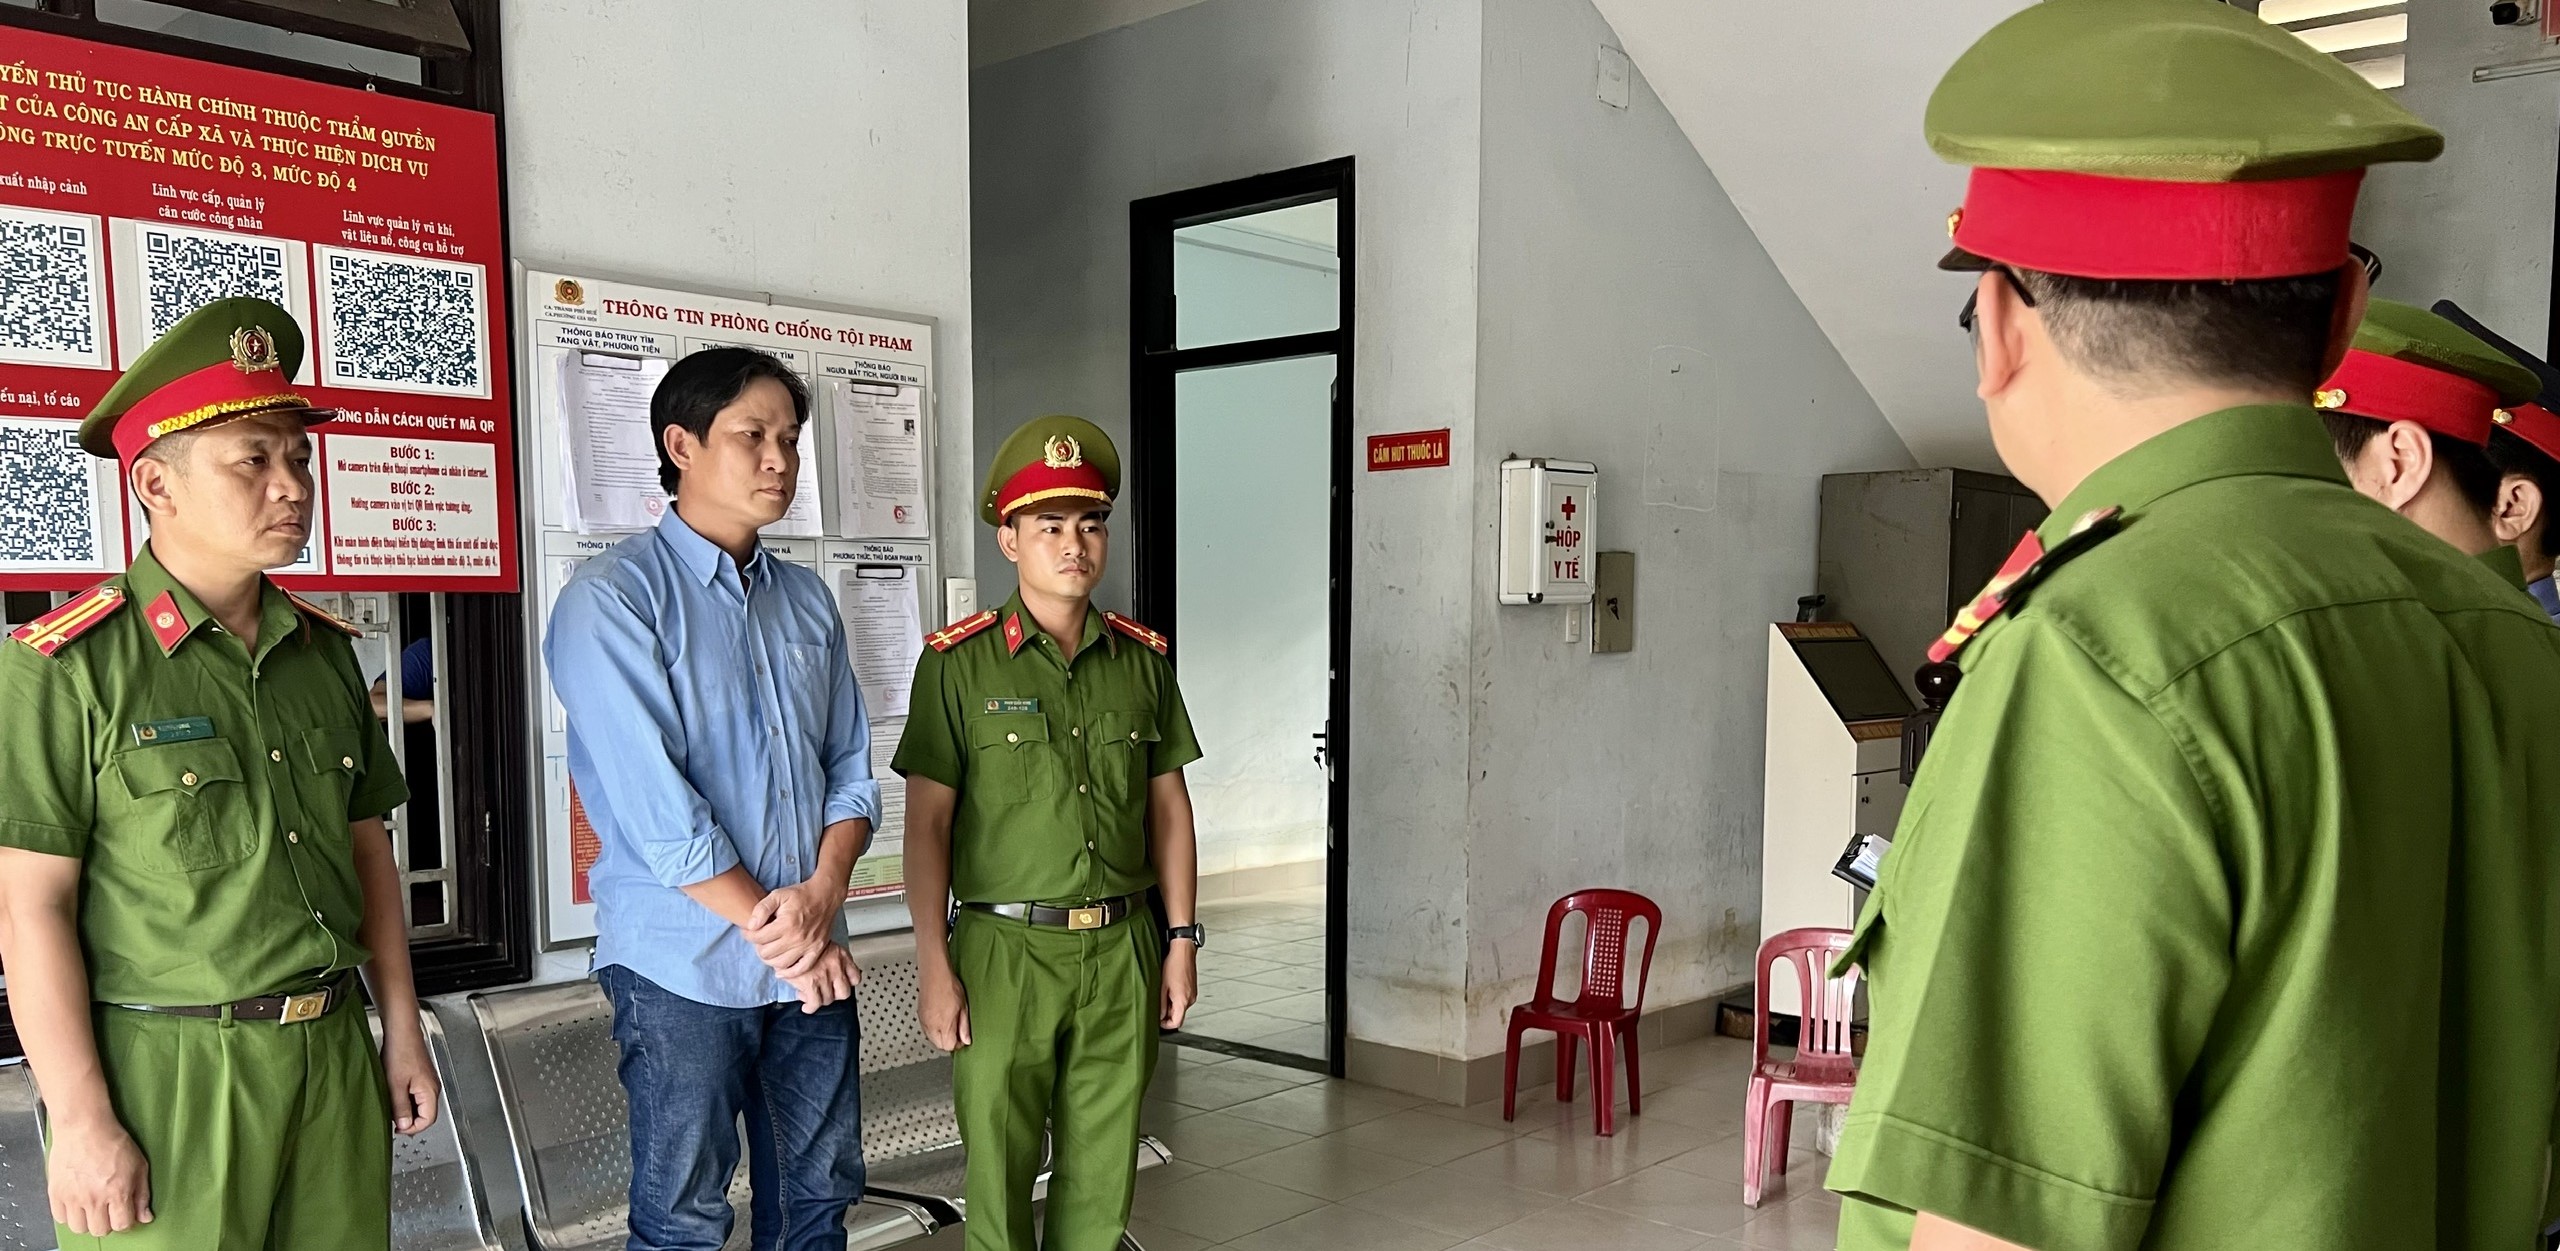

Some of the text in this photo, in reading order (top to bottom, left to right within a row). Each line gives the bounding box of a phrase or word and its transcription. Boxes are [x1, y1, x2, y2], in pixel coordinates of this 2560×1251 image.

[46, 70, 86, 94] THỦ
[93, 80, 132, 102] TỤC
[138, 85, 193, 110] HÀNH
[199, 97, 257, 122] CHÍNH
[261, 107, 322, 134] THUỘC
[326, 115, 376, 142] THẨM
[381, 127, 435, 152] QUYỀN
[16, 93, 59, 118] CỦA
[63, 102, 118, 128] CÔNG
[123, 112, 149, 132] AN
[155, 113, 193, 138] CẤP
[198, 124, 226, 144] XÃ
[229, 128, 256, 150] VÀ
[259, 135, 309, 158] THỰC
[313, 143, 356, 167] HIỆN
[361, 151, 403, 173] DỊCH
[406, 162, 429, 179] VỤ
[42, 130, 97, 155] TRỰC
[102, 138, 166, 164] TUYẾN
[171, 147, 215, 171] MỨC
[219, 155, 245, 178] ĐỘ
[251, 162, 268, 181] 3,
[273, 164, 313, 185] MỨC
[317, 170, 340, 192] ĐỘ
[346, 177, 357, 192] 4
[27, 176, 57, 195] nhập
[59, 178, 88, 196] cảnh
[152, 182, 265, 214] Lĩnh vực cấp, quản lý
[158, 203, 263, 230] căn cước công nhân
[342, 209, 455, 238] Lĩnh vực quản lý vũ khí,
[341, 228, 464, 258] vật liệu nổ, công cụ hỗ trợ
[561, 326, 655, 345] THÔNG BÁO TRUY TÌM
[602, 299, 913, 353] THÔNG TIN PHÒNG CHỐNG TỘI PHẠM
[556, 336, 661, 355] TANG VẬT, PHƯƠNG TIỆN
[18, 390, 41, 408] nại,
[44, 390, 57, 406] tố
[60, 392, 80, 407] cáo
[331, 406, 495, 434] ỚNG DẪN CÁCH QUÉT MÃ QR
[390, 444, 435, 460] BƯỚC 1:
[1373, 438, 1443, 464] CẤM HÚT THUỐC LÁ
[390, 480, 435, 496] BƯỚC 2:
[392, 516, 437, 532] BƯỚC 3:
[576, 540, 605, 550] THÔNG
[1556, 525, 1581, 552] HỘP
[1554, 555, 1581, 579] Y TẾ
